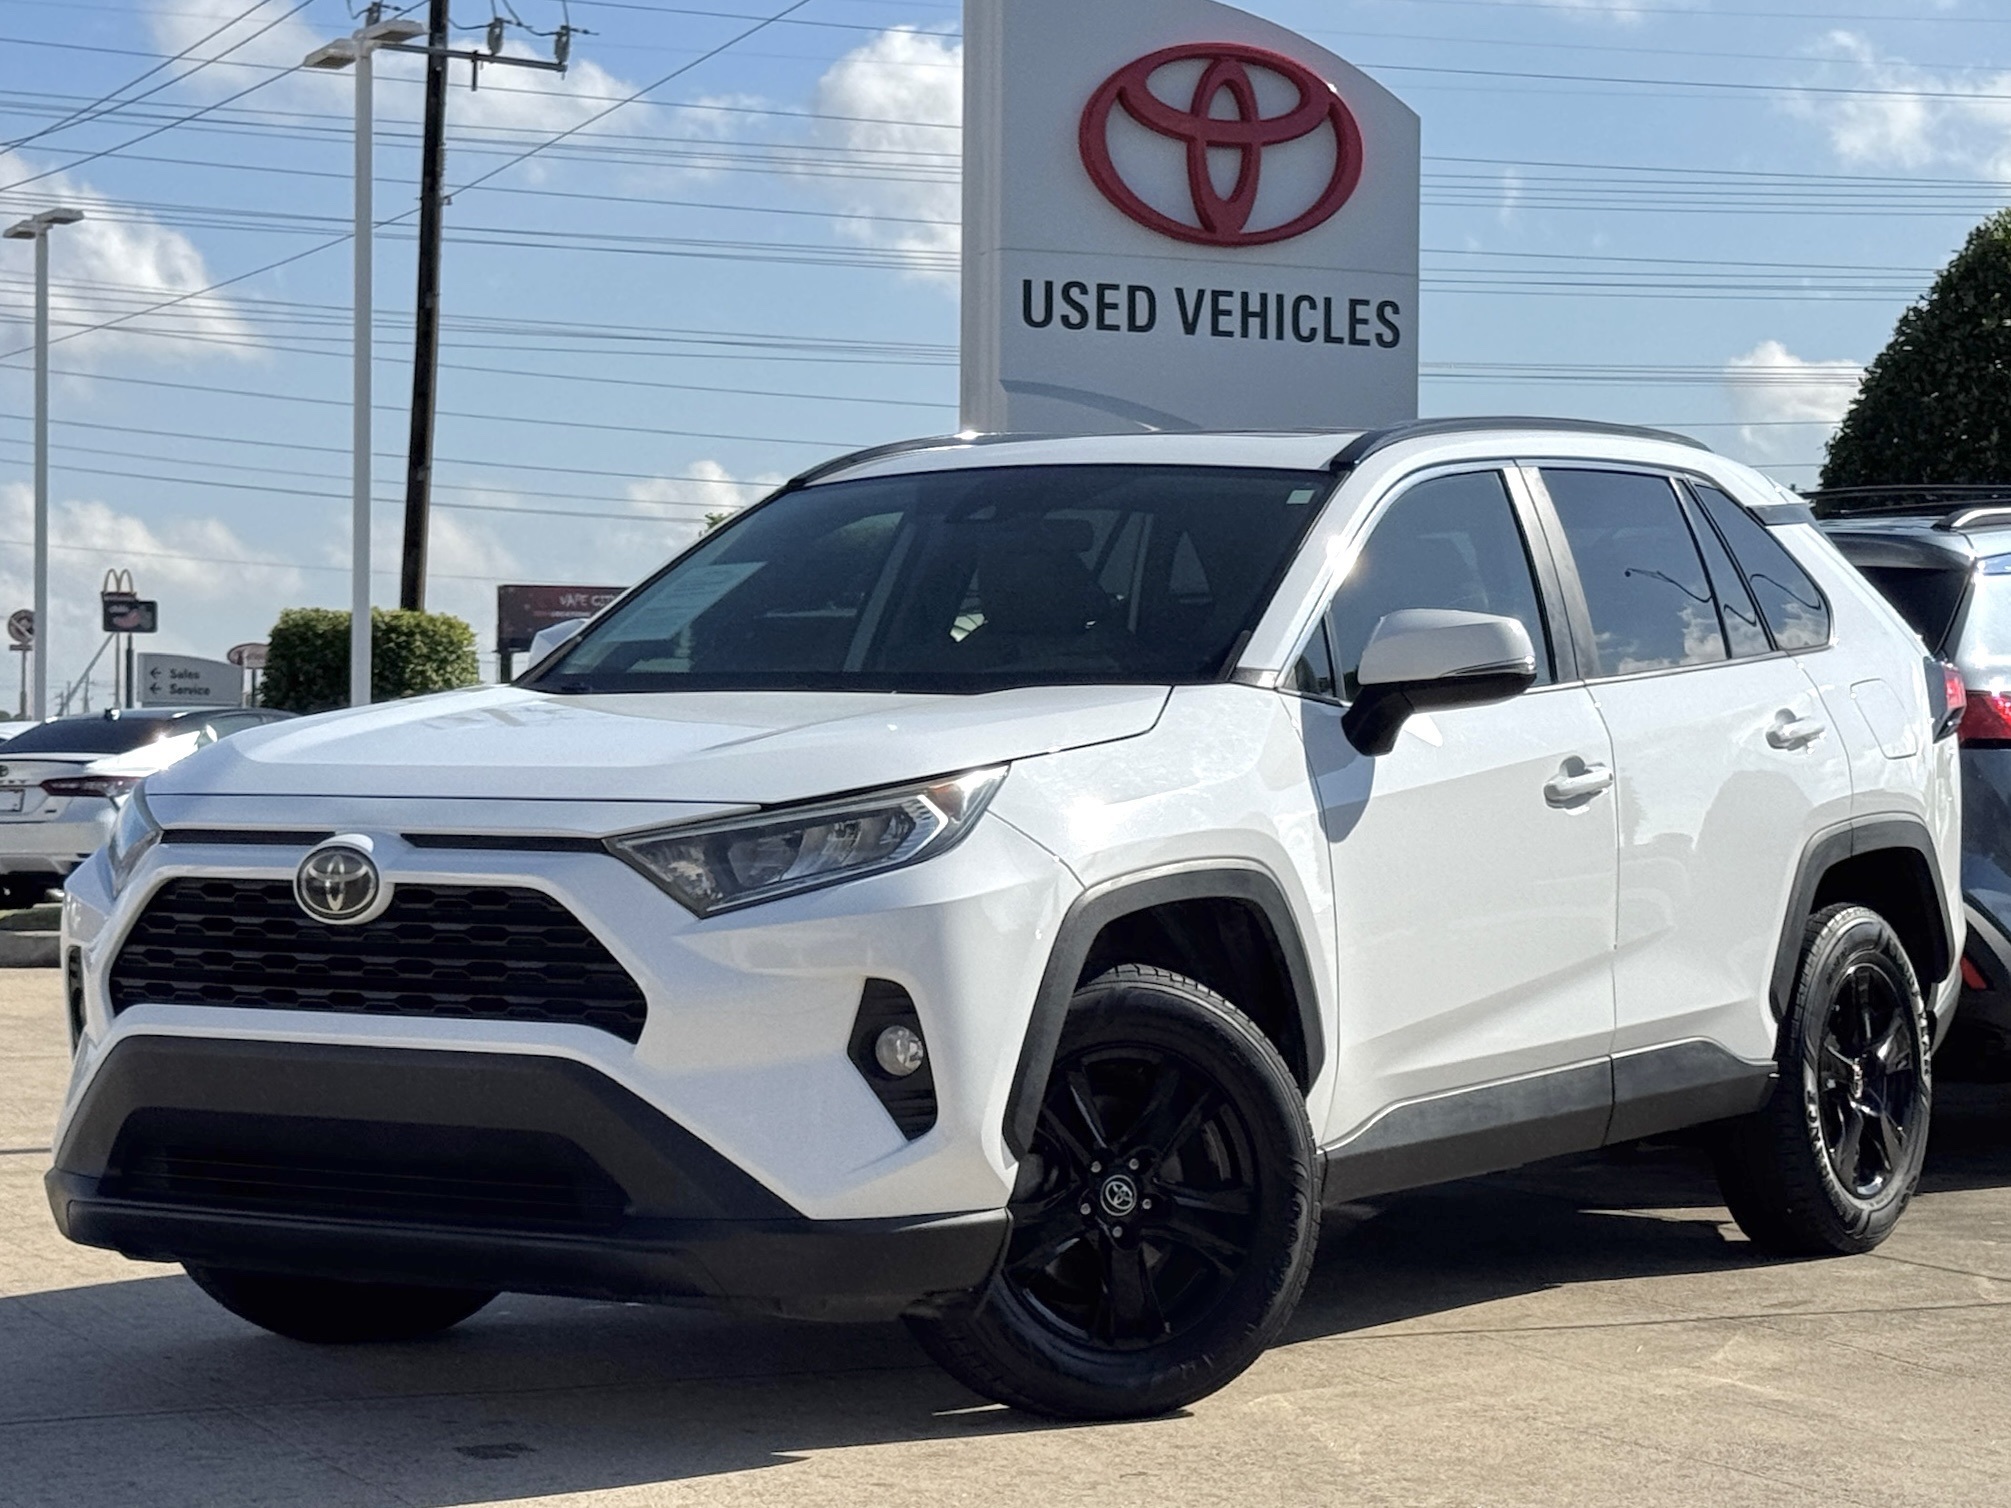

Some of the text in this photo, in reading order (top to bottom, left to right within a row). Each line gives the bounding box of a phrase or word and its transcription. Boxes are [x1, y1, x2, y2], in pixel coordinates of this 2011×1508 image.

[1022, 279, 1401, 349] USED VEHICLES
[169, 668, 201, 679] Sales
[169, 683, 211, 696] Service
